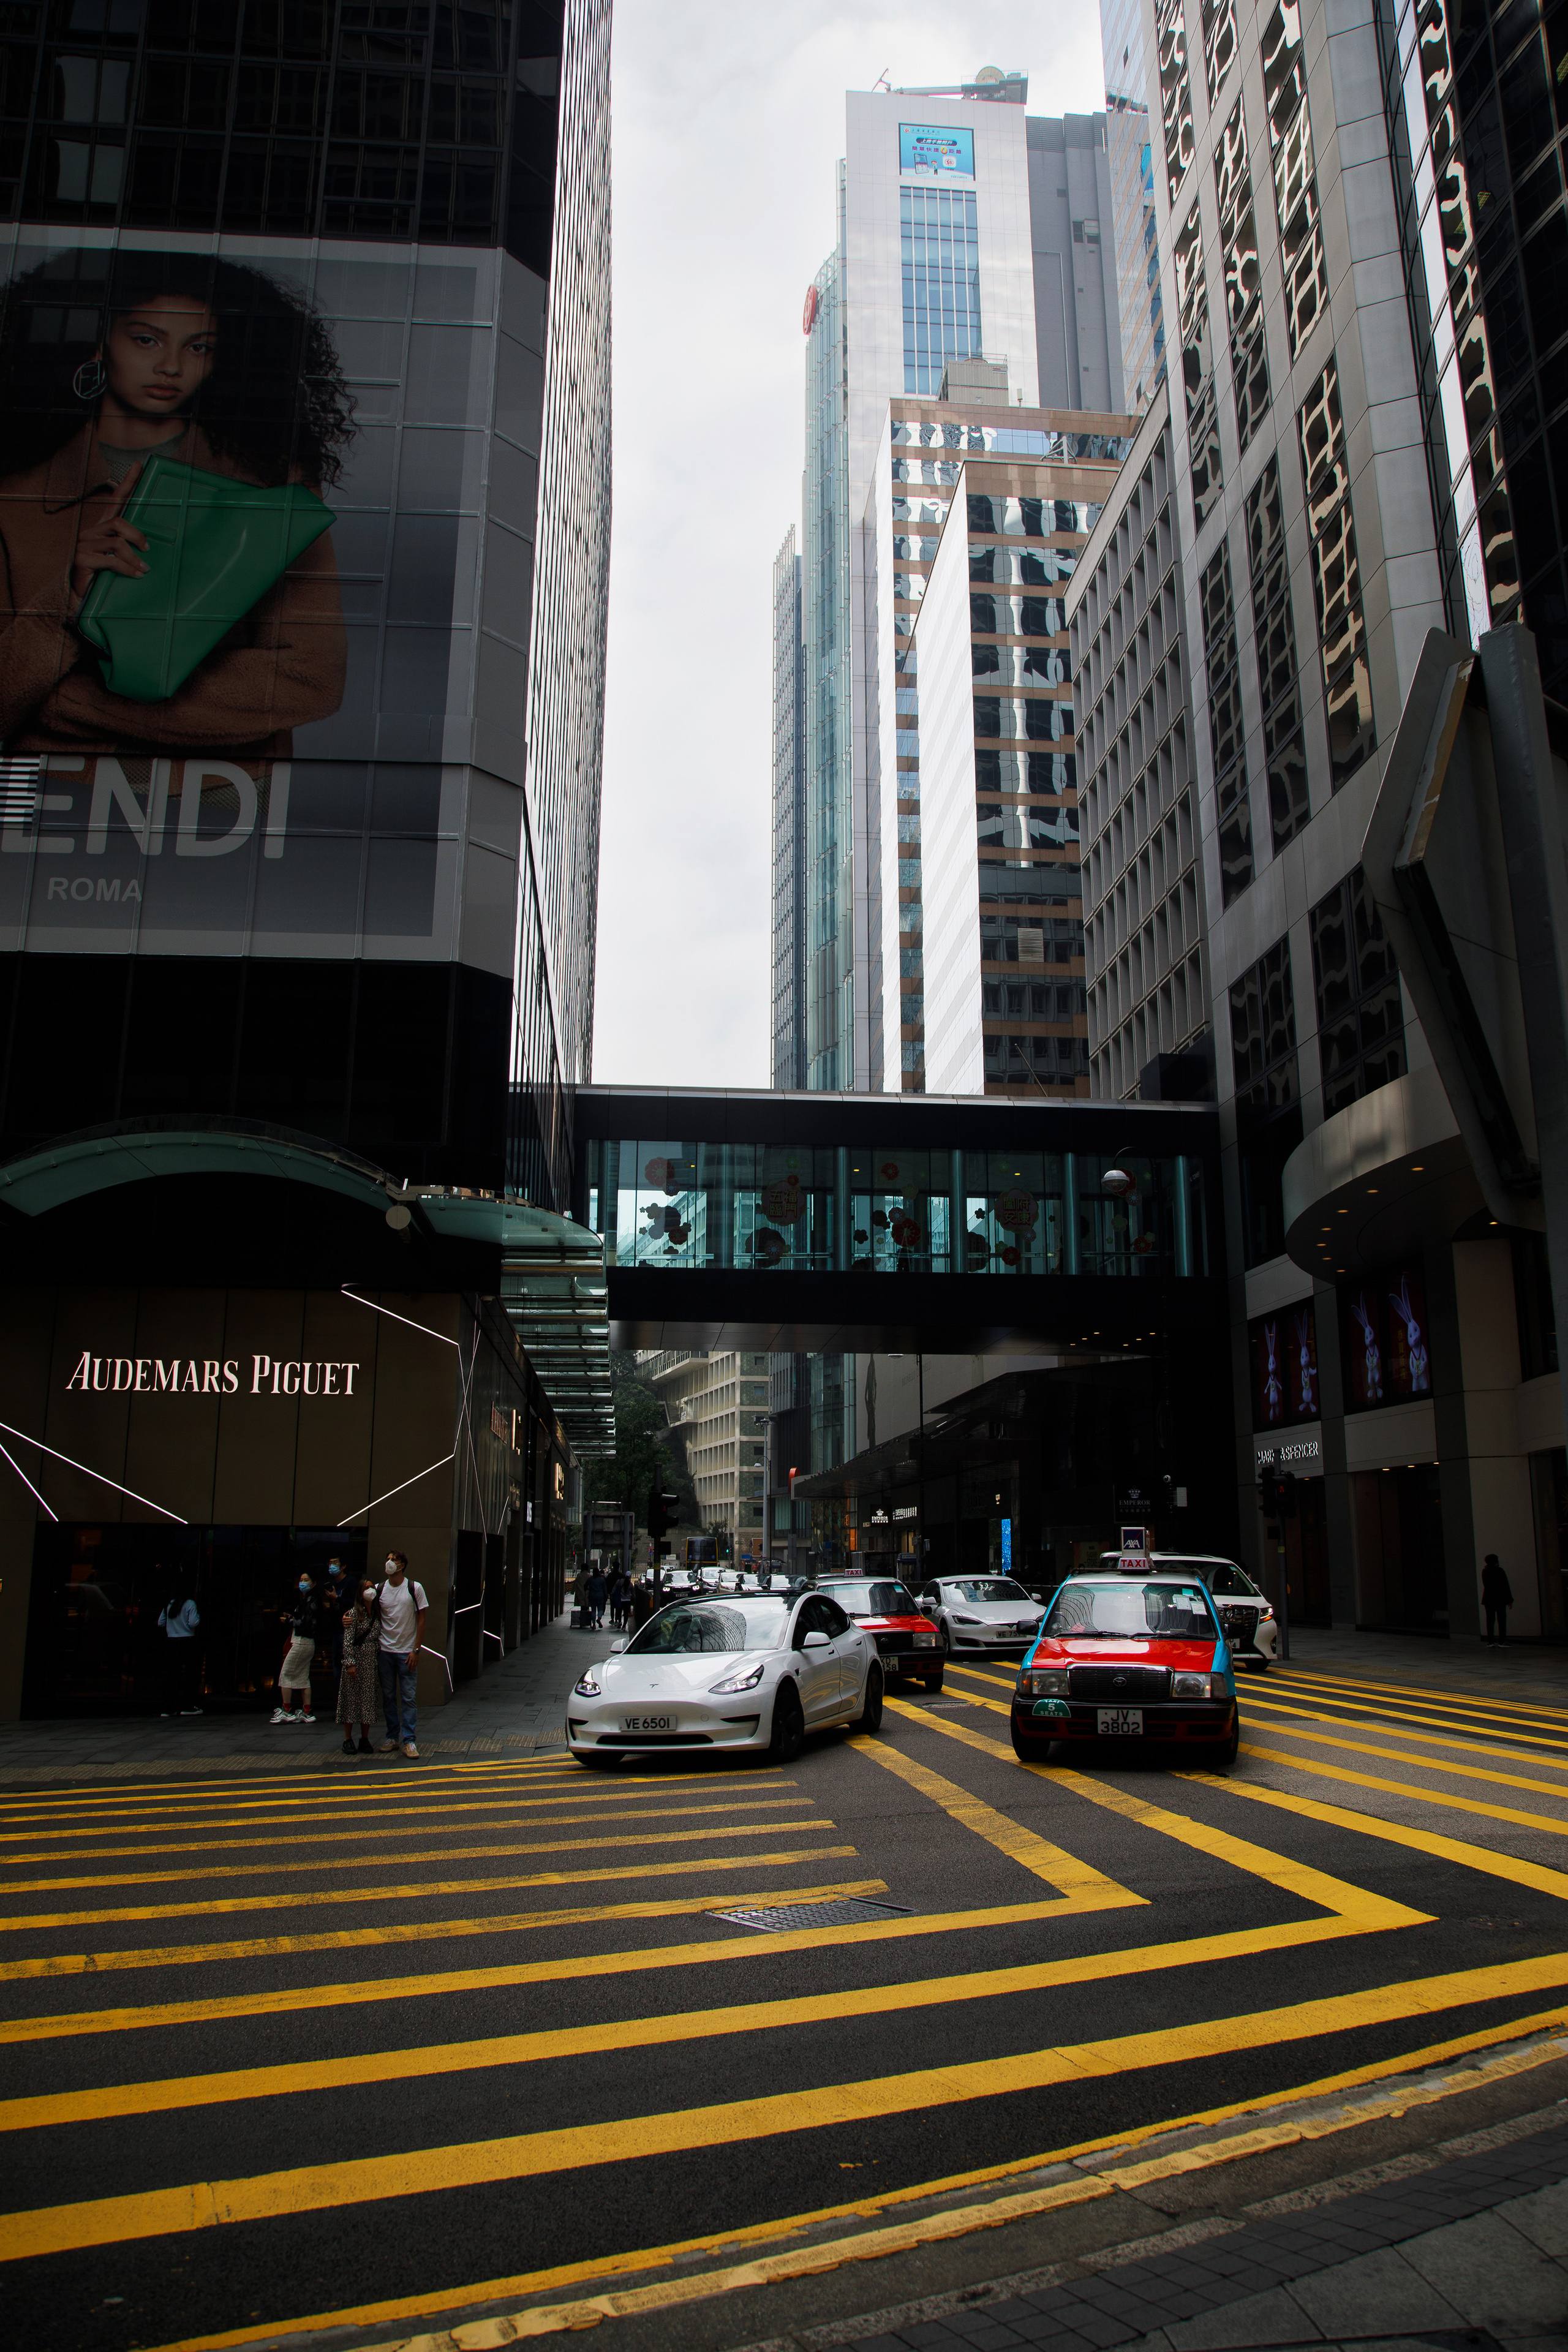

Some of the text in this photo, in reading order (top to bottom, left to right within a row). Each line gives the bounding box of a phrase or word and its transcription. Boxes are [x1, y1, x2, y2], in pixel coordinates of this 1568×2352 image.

[0, 756, 292, 859] ENDI
[47, 877, 143, 902] ROMA
[769, 1189, 797, 1203] 五福
[769, 1203, 797, 1218] 臨門
[1003, 1211, 1030, 1225] 安康
[65, 1351, 360, 1395] AUDEMARS PIGUET
[1257, 1449, 1275, 1464] MARK
[1285, 1441, 1319, 1460] SPENCER
[1123, 1539, 1140, 1548] AXA
[625, 1717, 670, 1729] VE 6501
[1110, 1710, 1129, 1722] JV
[1101, 1721, 1140, 1734] 3802
